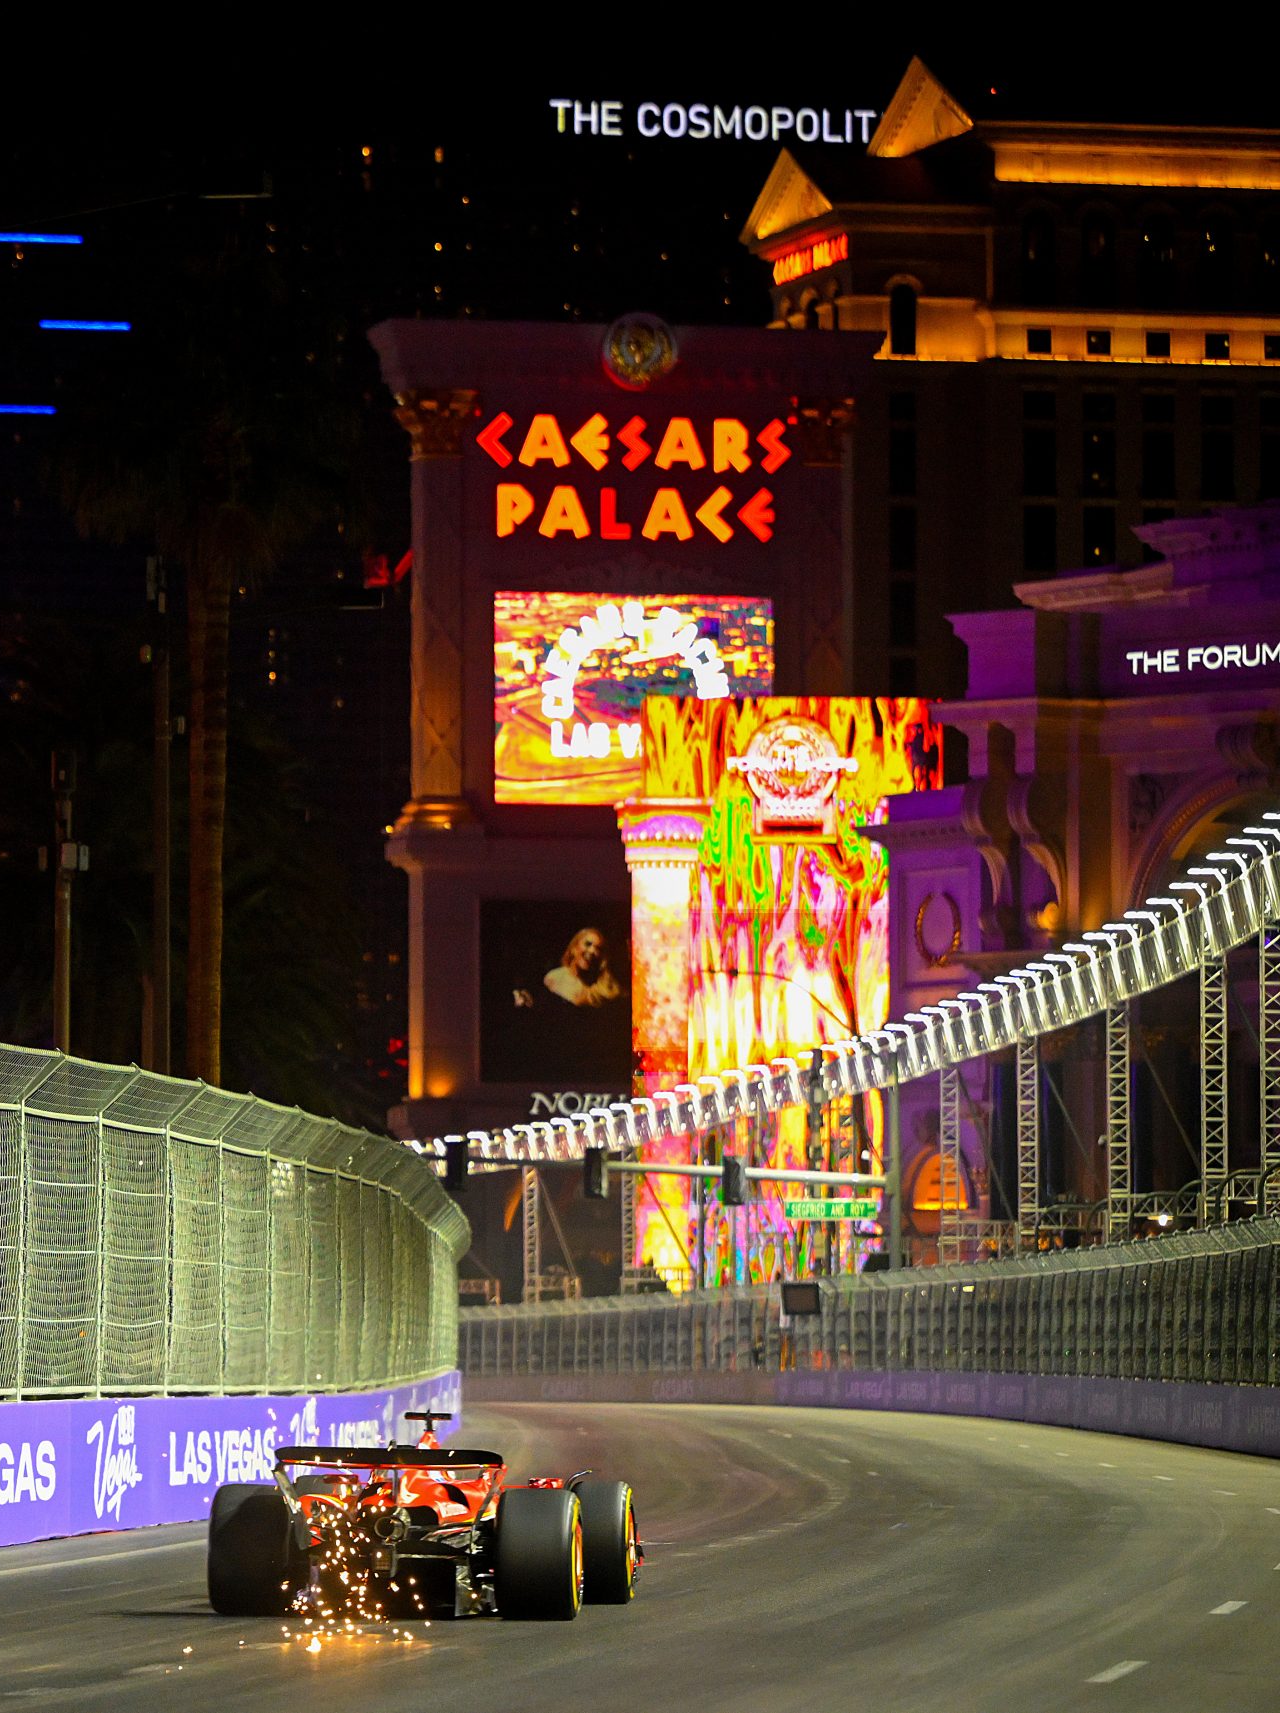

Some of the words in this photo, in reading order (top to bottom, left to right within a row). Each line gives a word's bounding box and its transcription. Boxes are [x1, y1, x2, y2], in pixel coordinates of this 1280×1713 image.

[549, 99, 623, 136] THE
[637, 103, 878, 144] COSMOPOLIT
[476, 412, 792, 475] CAESARS
[496, 483, 776, 543] PALACE
[1126, 648, 1180, 675] THE
[1187, 642, 1280, 672] FORUM
[831, 1202, 845, 1218] AND
[851, 1202, 865, 1218] ROY
[170, 1431, 212, 1486] LAS
[214, 1428, 276, 1483] VEGAS
